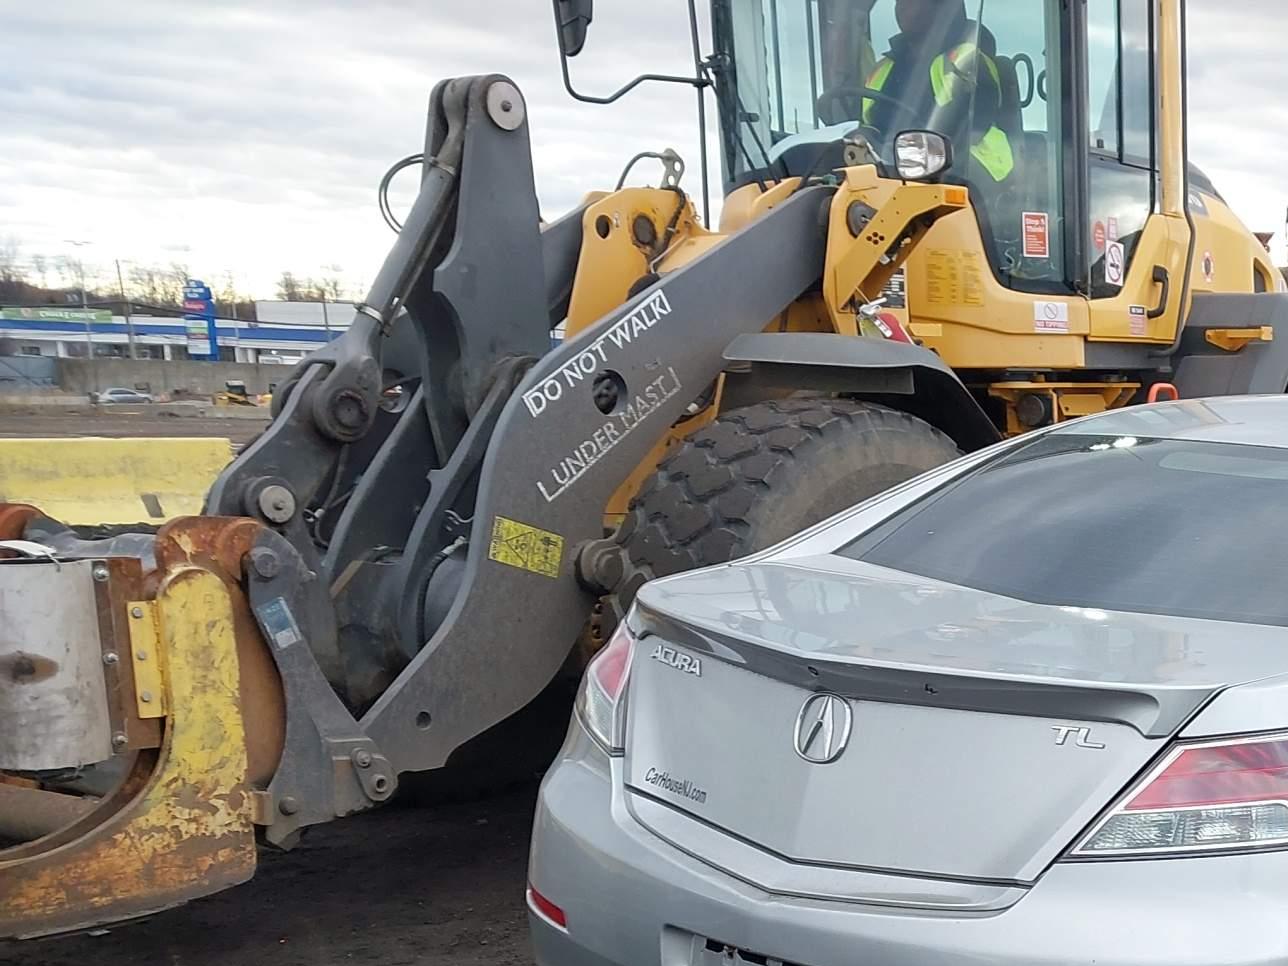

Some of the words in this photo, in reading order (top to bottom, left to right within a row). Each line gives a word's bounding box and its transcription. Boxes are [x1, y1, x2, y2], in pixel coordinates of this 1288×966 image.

[527, 380, 562, 414] DO
[562, 341, 608, 388] NOT
[608, 296, 669, 350] WALK
[551, 421, 620, 485] UNDER
[619, 375, 668, 429] MAST
[650, 645, 702, 677] ACURA
[1051, 725, 1105, 749] TL
[645, 767, 707, 804] CarHouseNJ.com
